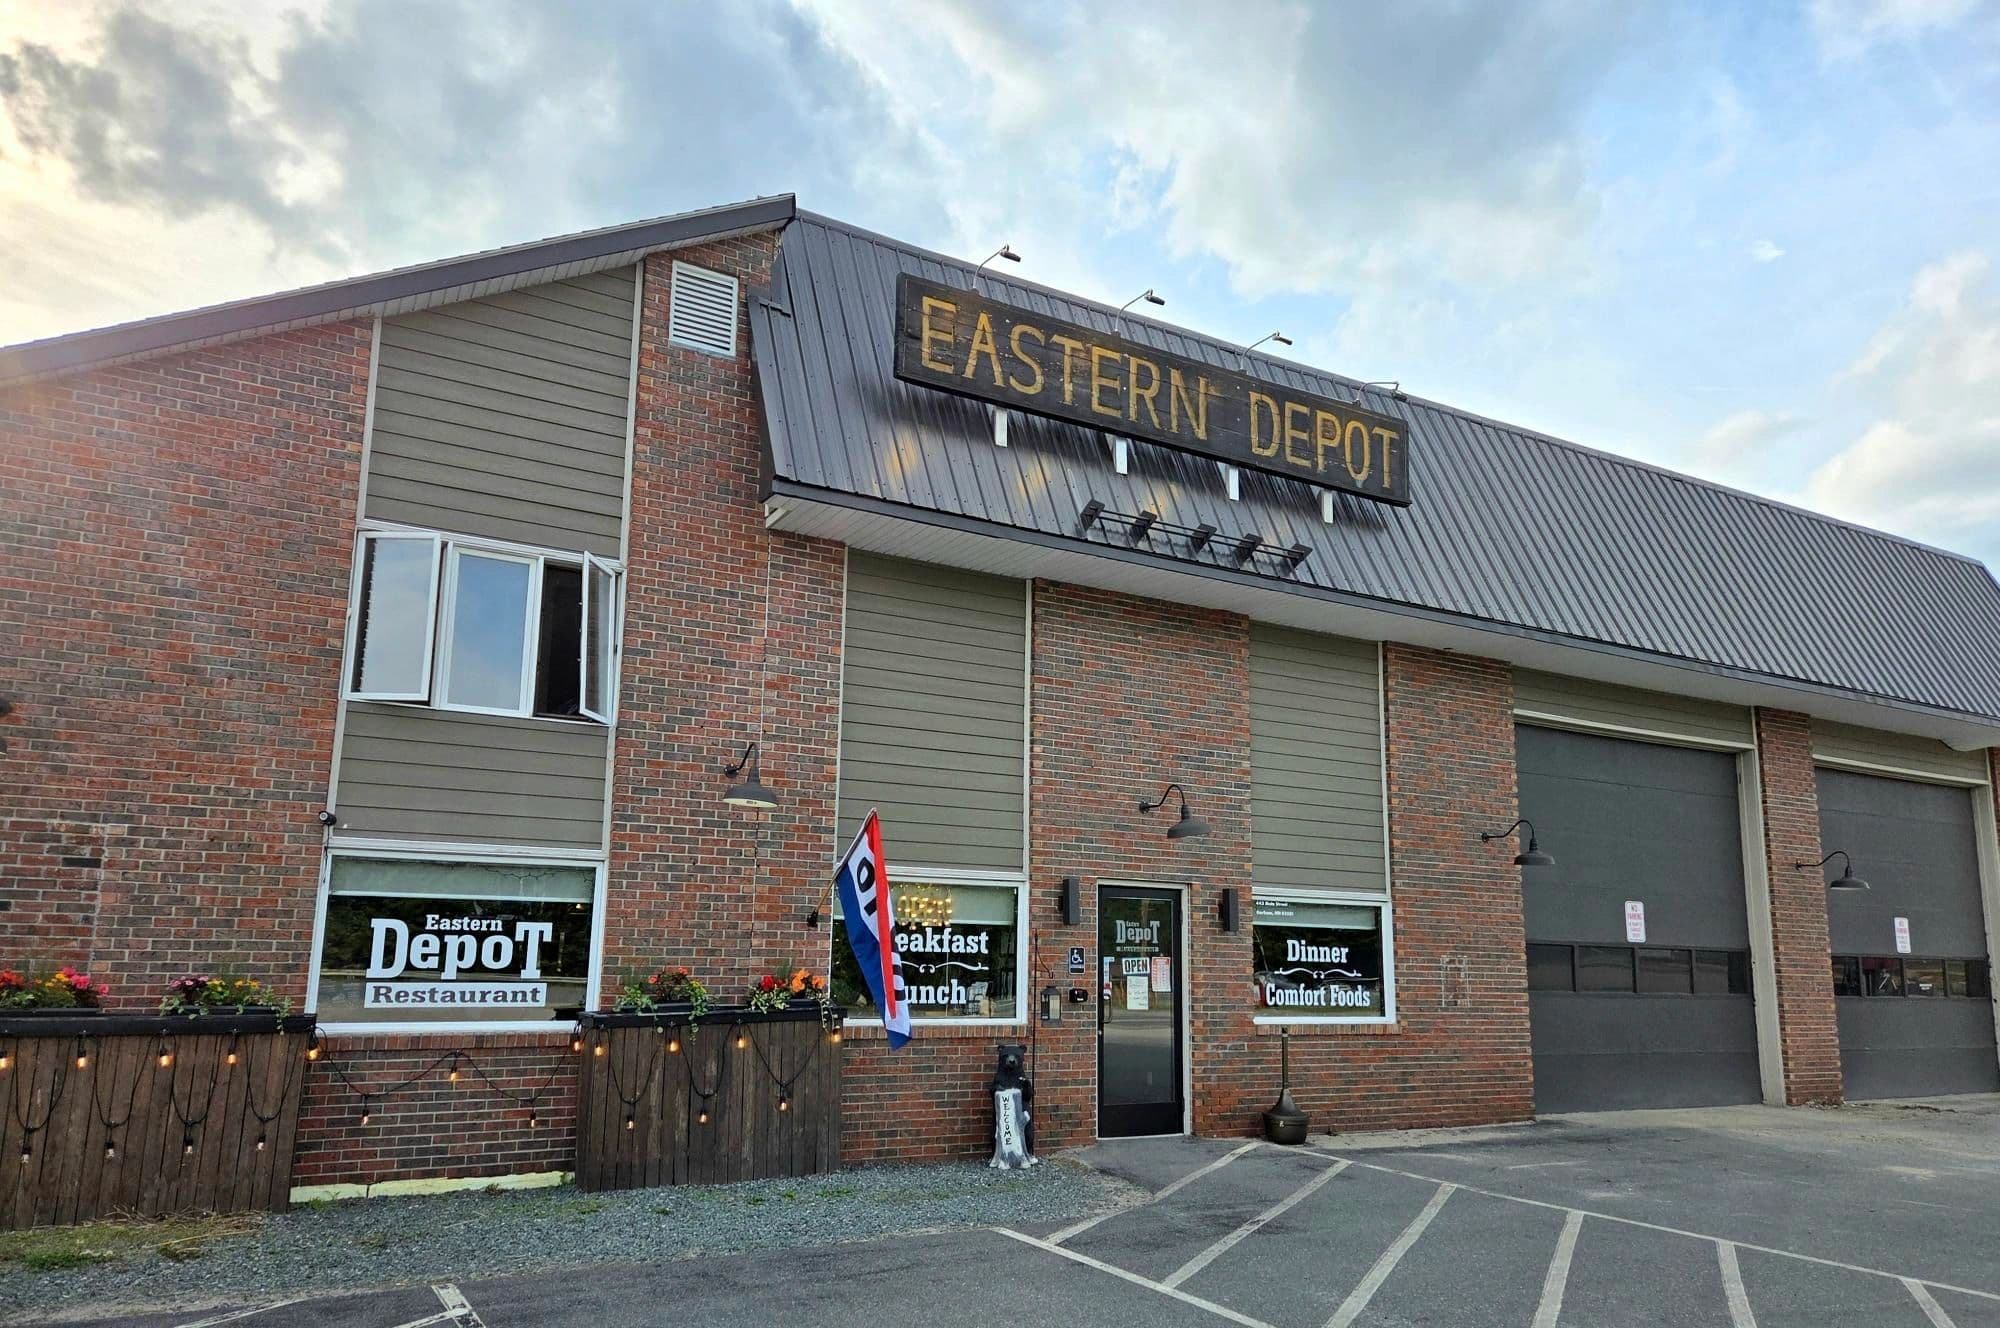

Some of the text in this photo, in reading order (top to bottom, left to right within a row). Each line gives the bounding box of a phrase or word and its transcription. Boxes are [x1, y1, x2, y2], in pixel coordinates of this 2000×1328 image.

[921, 295, 1399, 489] EASTERN DEPOT
[425, 914, 503, 932] Eastern
[895, 928, 989, 954] eakfast
[1287, 939, 1349, 964] Dinner
[1124, 959, 1148, 973] OPEN
[371, 985, 541, 1004] Restaurant
[905, 979, 967, 1005] unch
[1266, 983, 1371, 1007] Comfort Foods
[1002, 1095, 1012, 1146] WELCOME
